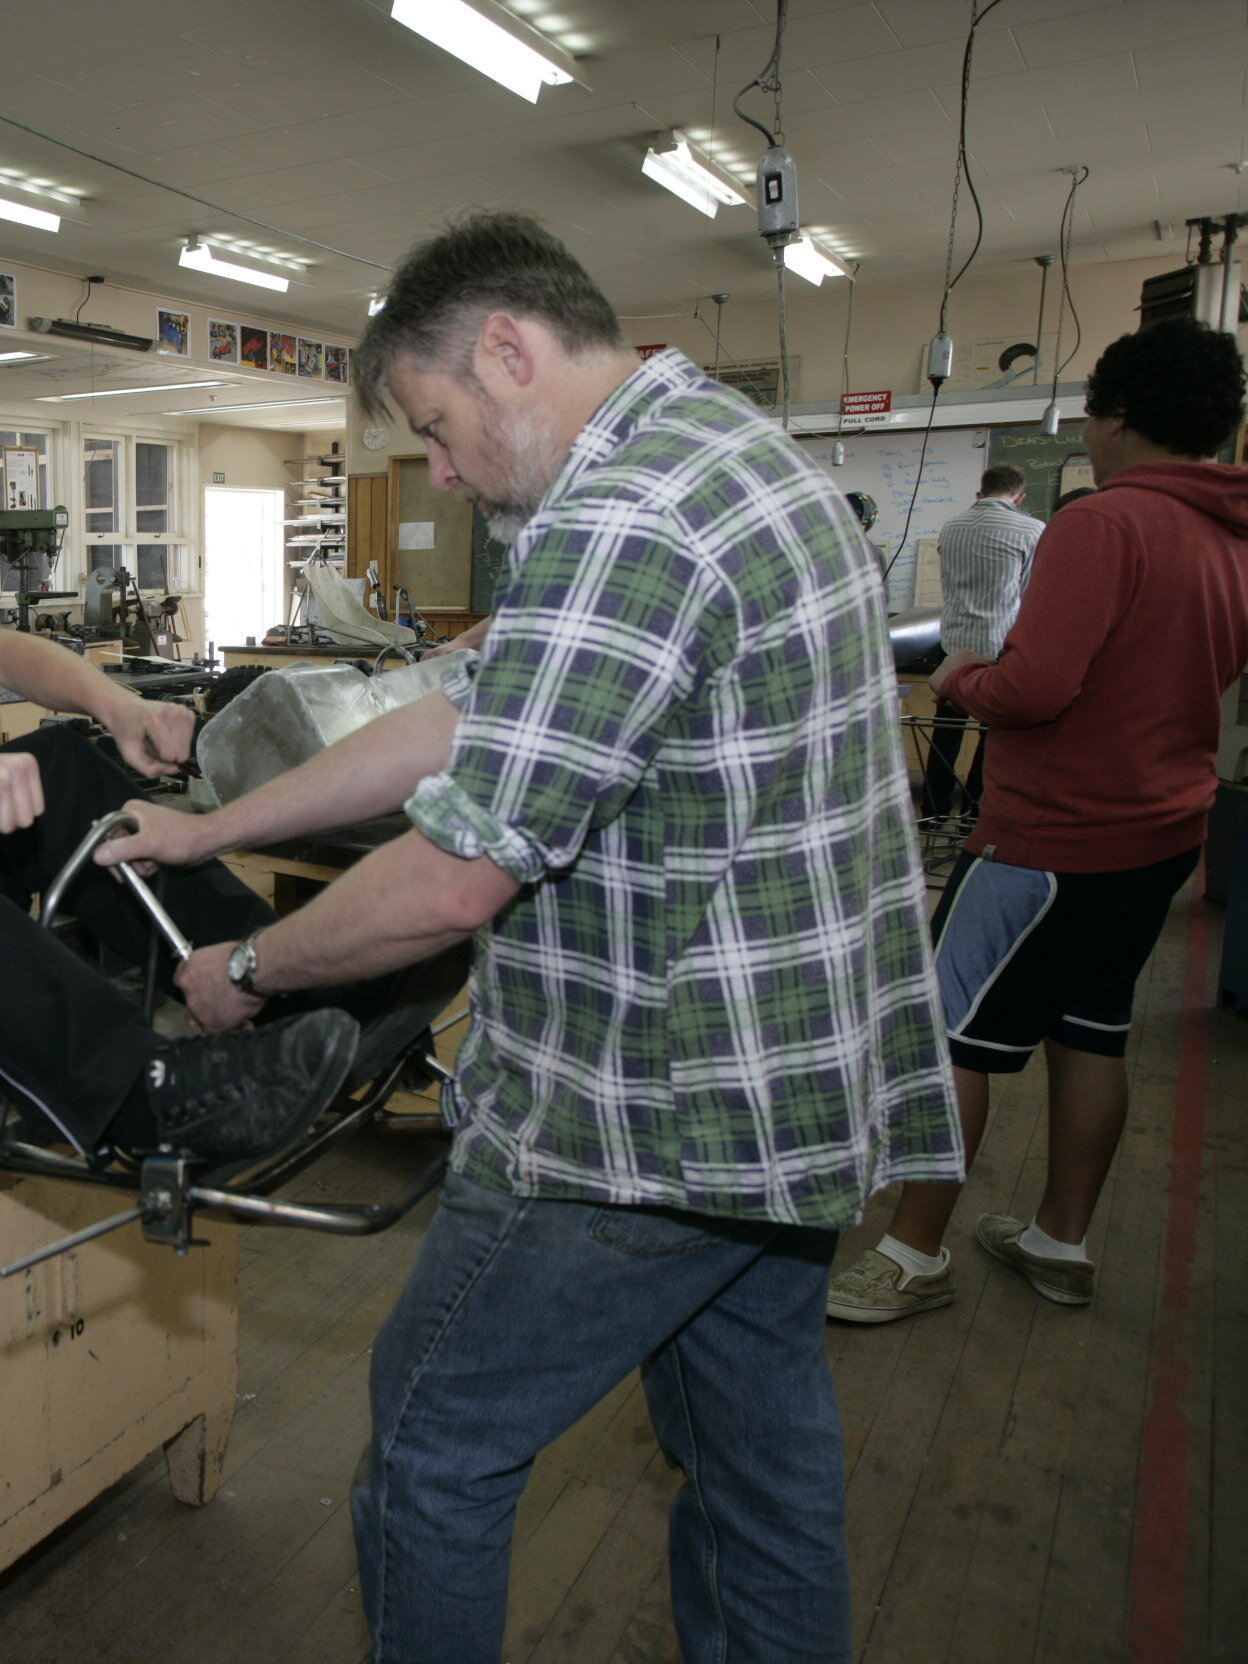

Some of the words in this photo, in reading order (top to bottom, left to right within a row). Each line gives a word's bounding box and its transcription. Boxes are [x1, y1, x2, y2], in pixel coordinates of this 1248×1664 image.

[843, 393, 888, 403] EMERGENCY
[845, 404, 870, 413] POWER
[871, 402, 886, 411] OFF
[998, 436, 1084, 448] DEAD-LIN
[213, 473, 225, 483] EXIT
